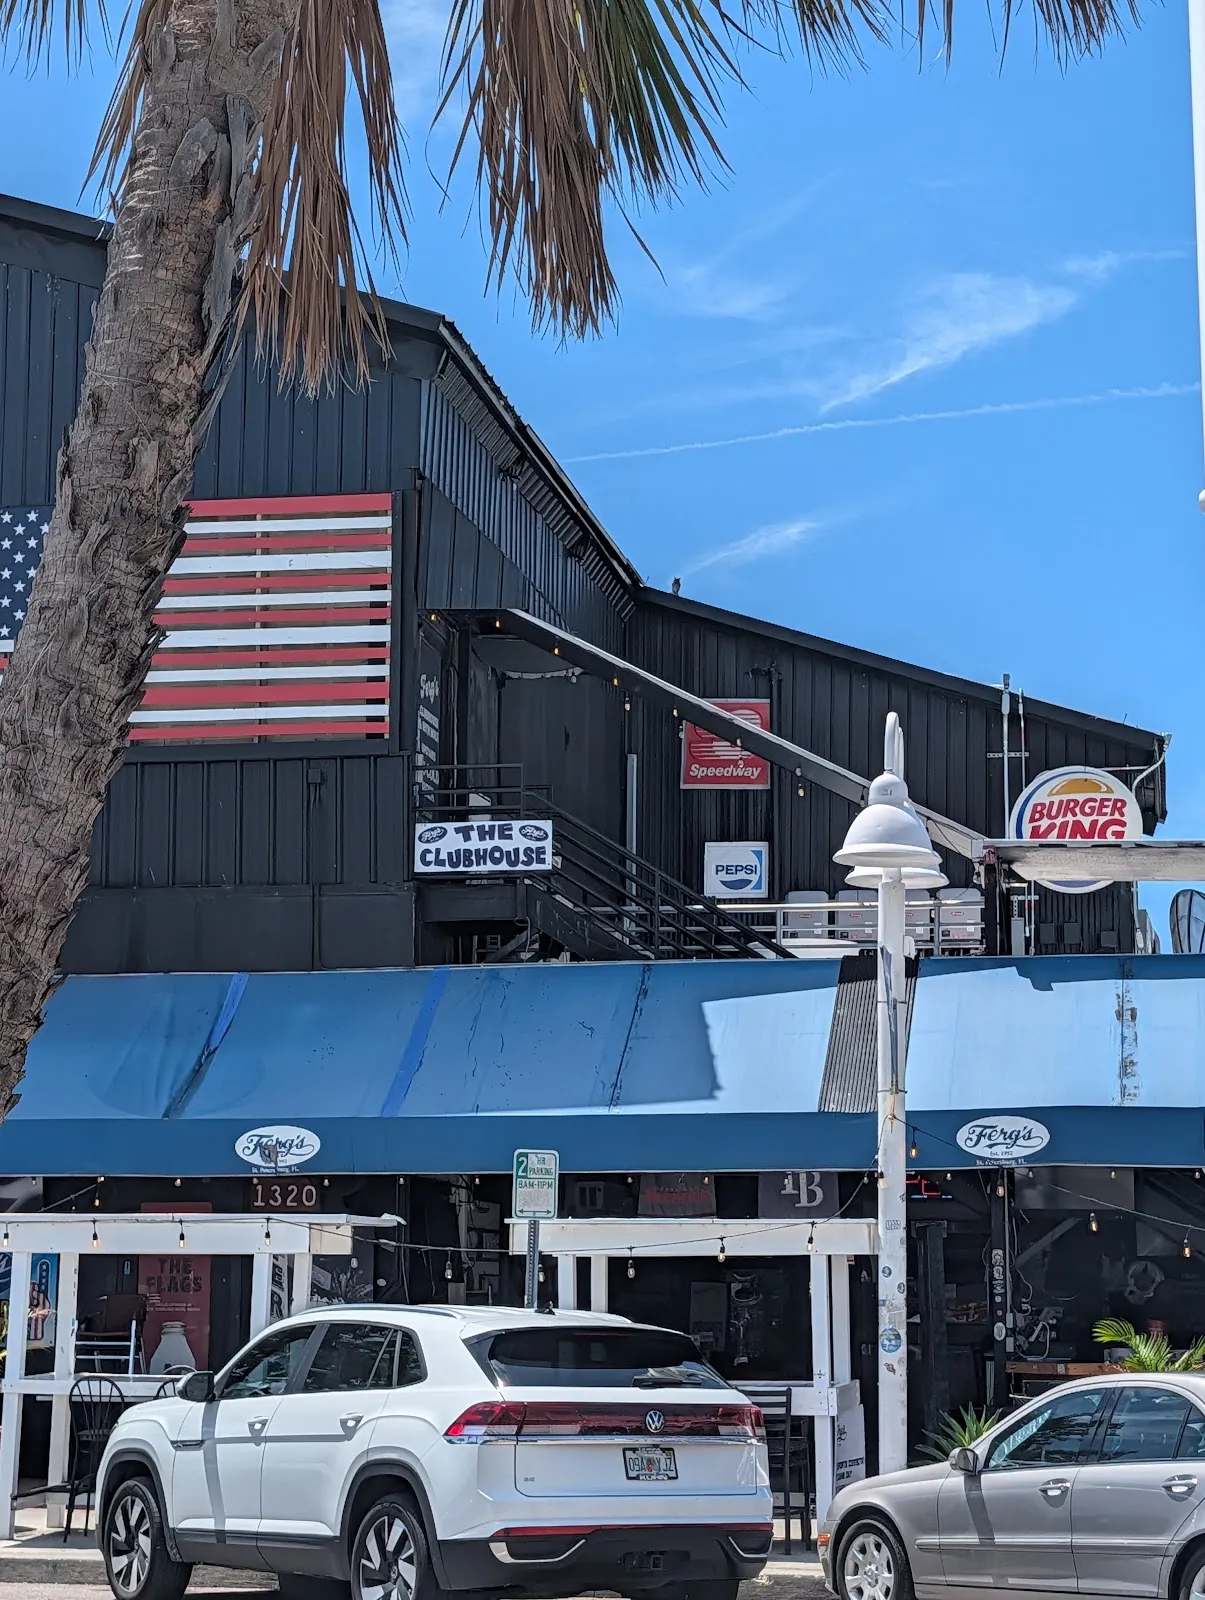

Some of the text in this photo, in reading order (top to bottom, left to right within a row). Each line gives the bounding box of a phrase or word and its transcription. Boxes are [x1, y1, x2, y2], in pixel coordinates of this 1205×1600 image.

[690, 764, 761, 779] Speedway
[1029, 798, 1127, 824] BURGER
[454, 823, 514, 842] THE
[1029, 818, 1127, 839] KING
[420, 845, 547, 869] CLUBHOUSE
[715, 864, 757, 875] PEPSI
[965, 1125, 1044, 1149] Ferg's
[518, 1156, 527, 1175] 2
[529, 1167, 553, 1176] PARKING
[253, 1184, 317, 1207] 1320
